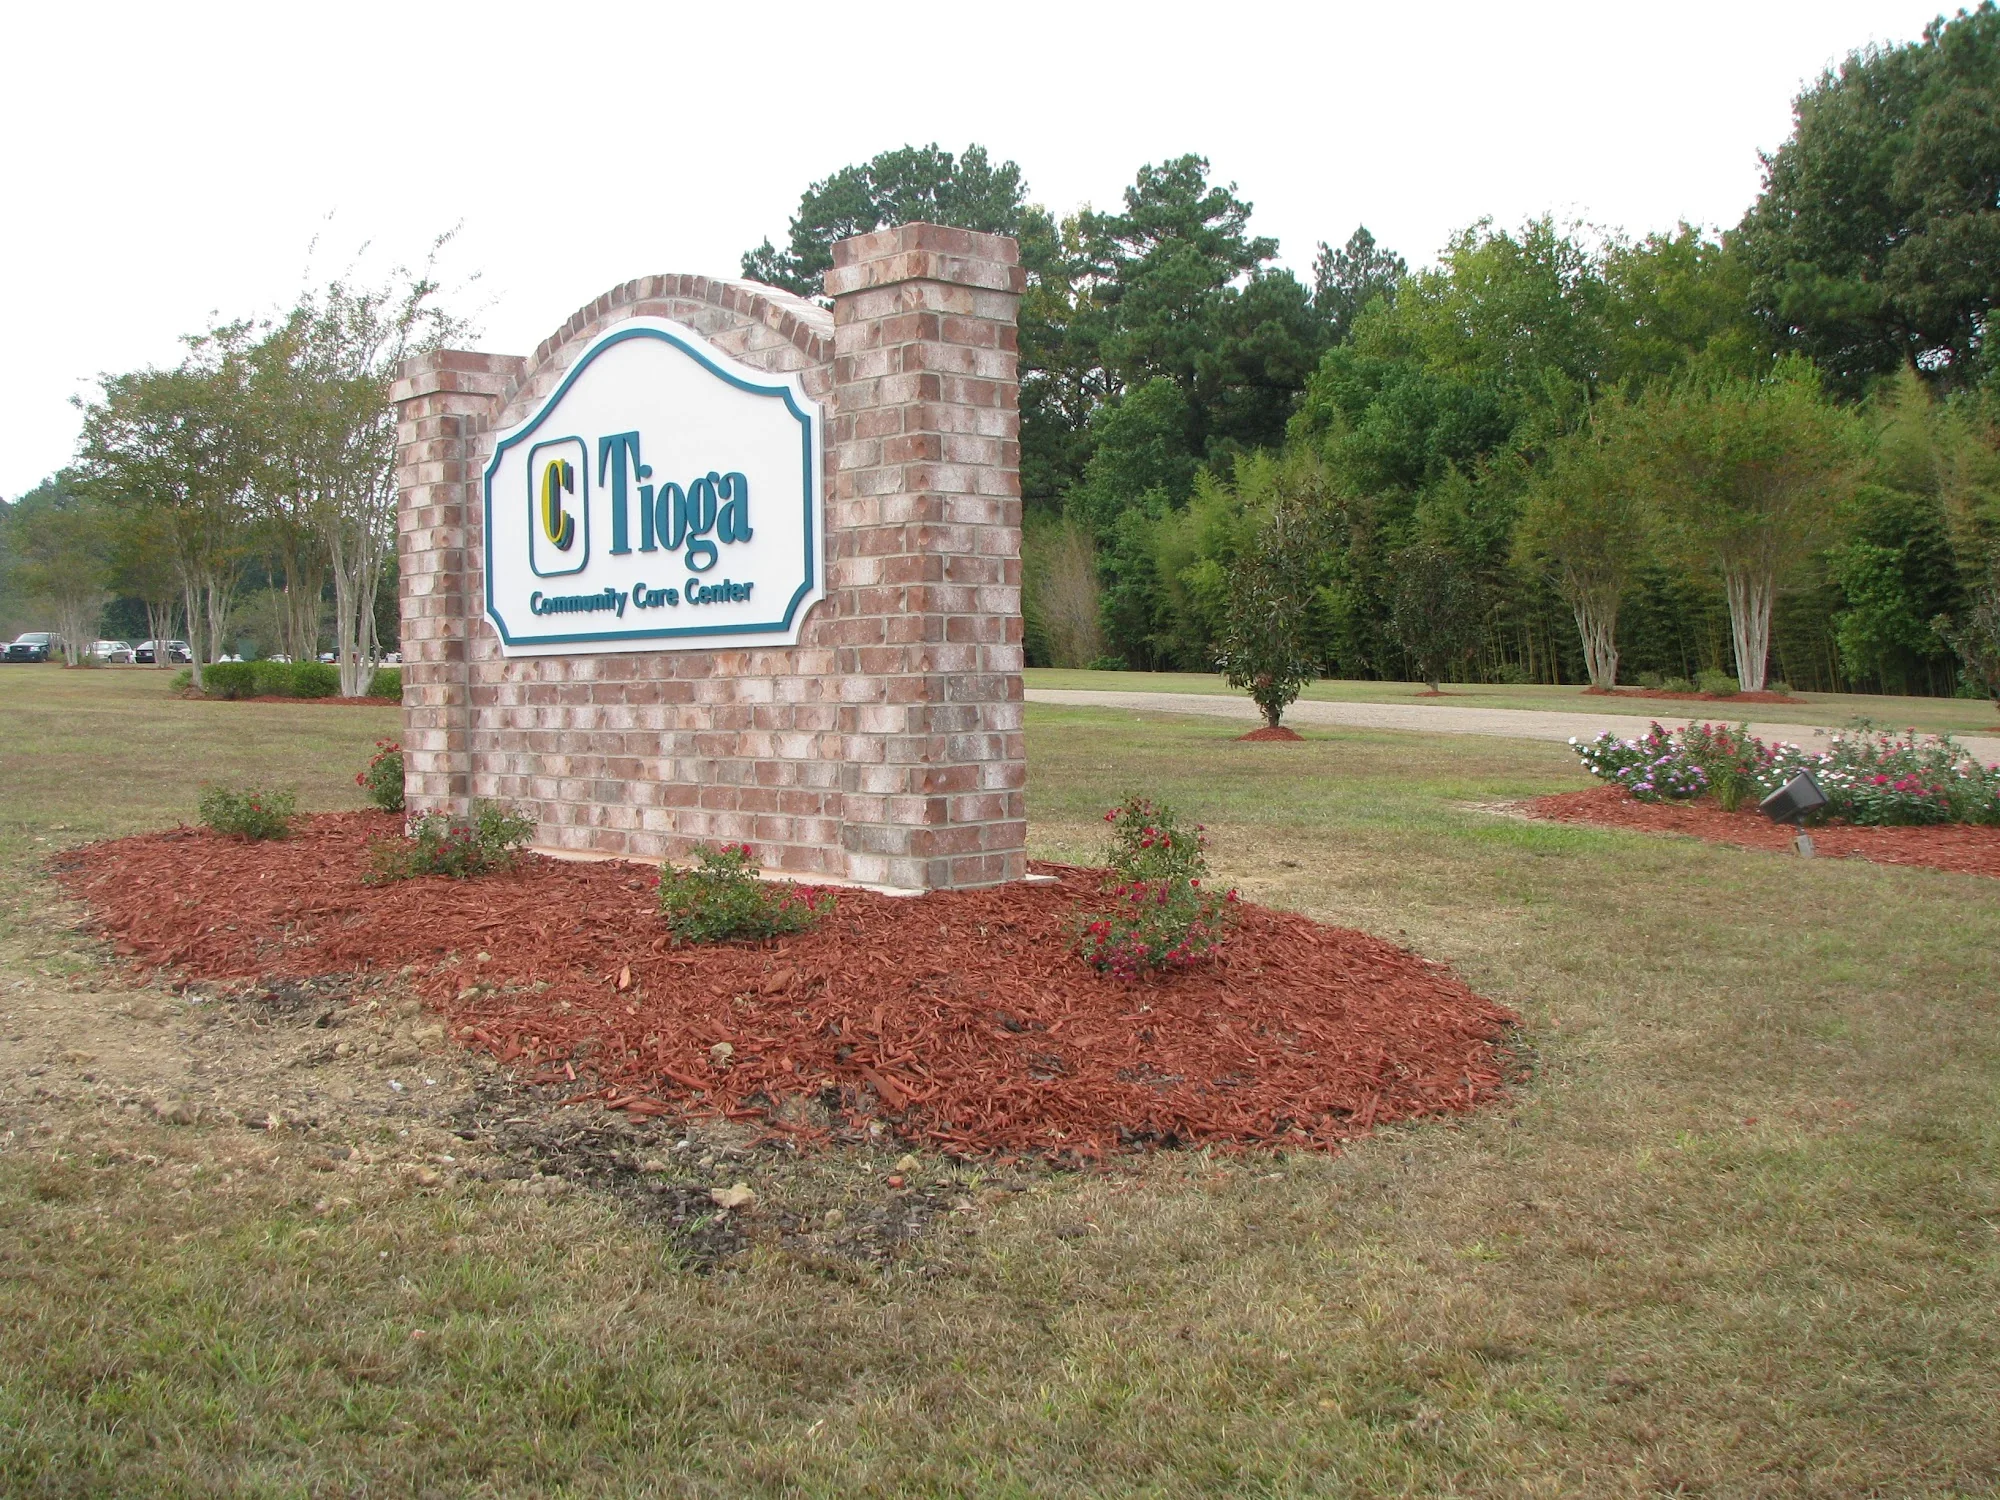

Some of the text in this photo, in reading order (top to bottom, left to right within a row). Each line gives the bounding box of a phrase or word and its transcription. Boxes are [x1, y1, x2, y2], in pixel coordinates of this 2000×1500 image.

[598, 431, 753, 573] Tioga
[530, 577, 754, 618] Community Care Center
